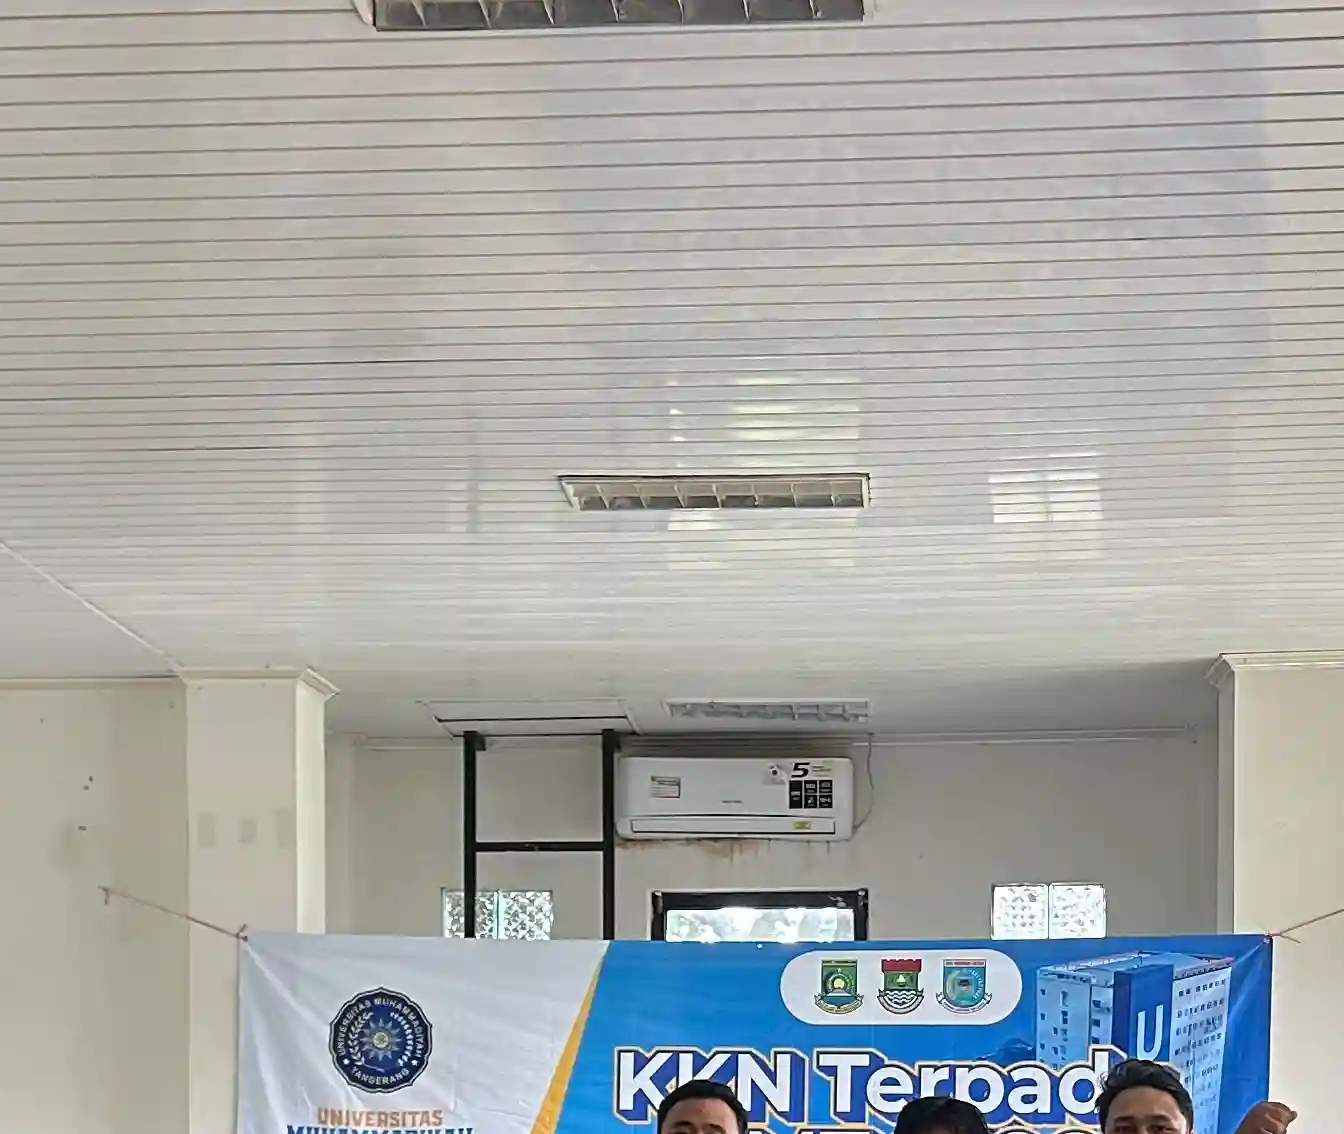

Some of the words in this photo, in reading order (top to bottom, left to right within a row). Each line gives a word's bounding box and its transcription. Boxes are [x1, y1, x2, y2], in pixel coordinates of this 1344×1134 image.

[791, 762, 810, 778] 5
[351, 1067, 410, 1085] TANGERANG
[618, 1052, 791, 1112] KKN
[818, 1050, 1102, 1115] Terpad
[317, 1107, 443, 1128] UNIVERSITAS
